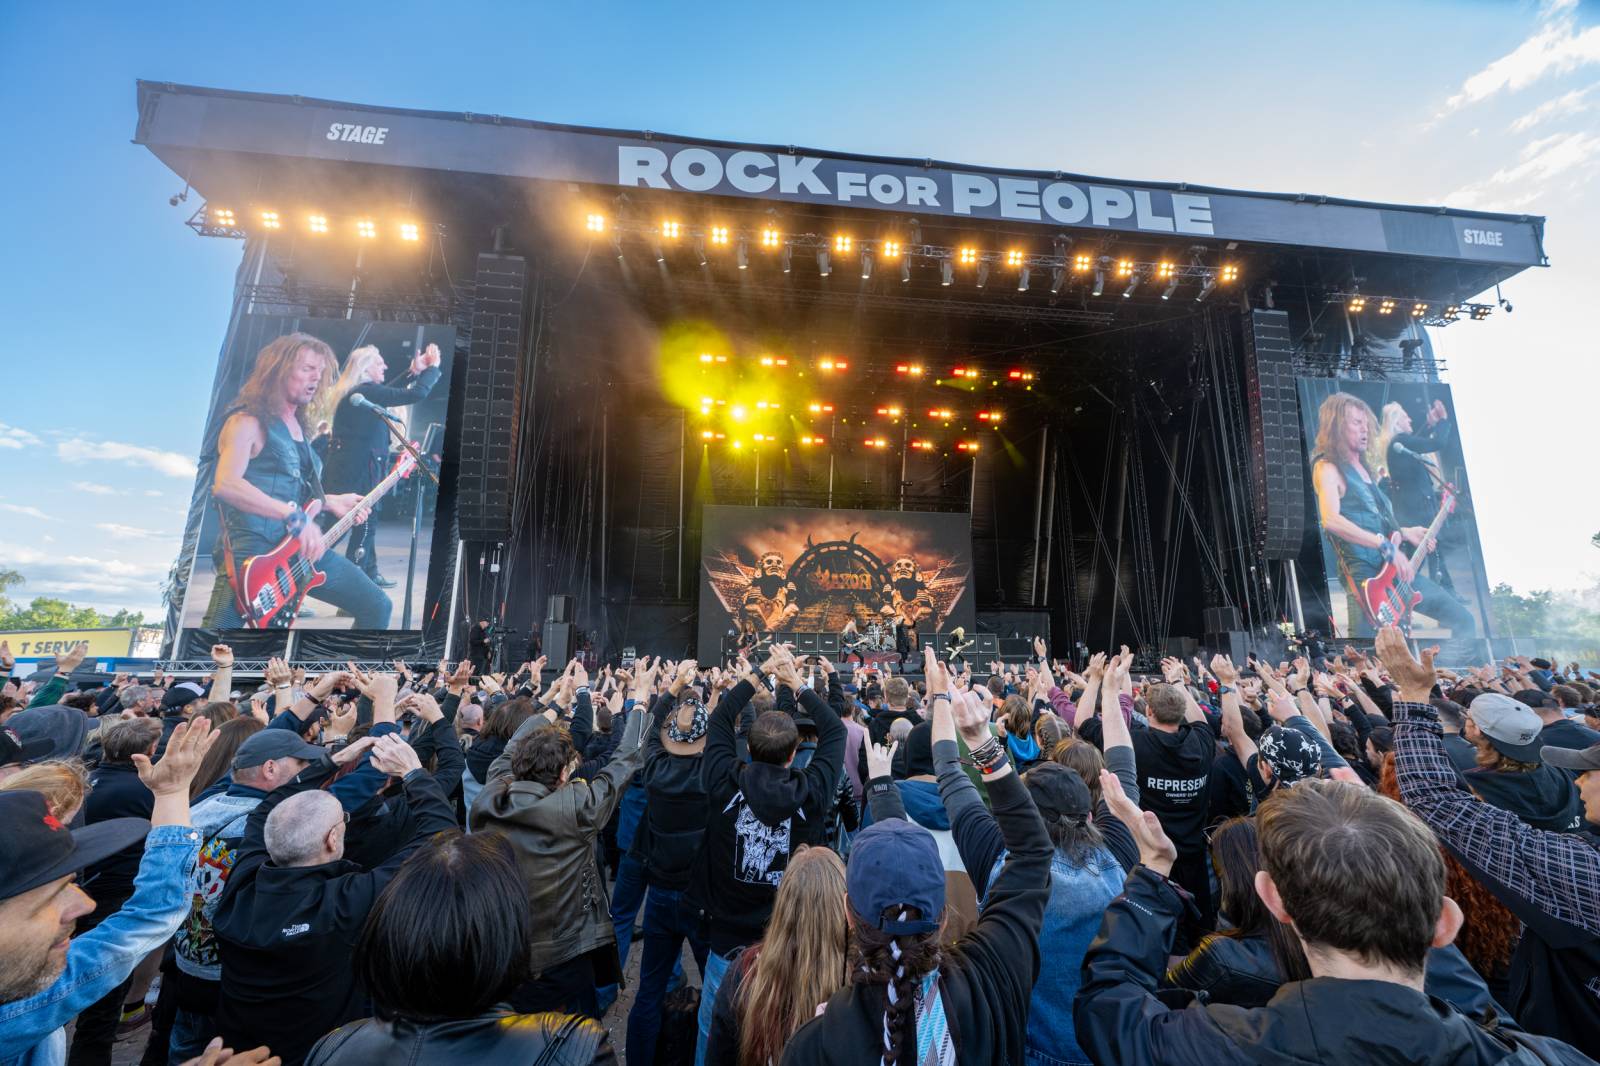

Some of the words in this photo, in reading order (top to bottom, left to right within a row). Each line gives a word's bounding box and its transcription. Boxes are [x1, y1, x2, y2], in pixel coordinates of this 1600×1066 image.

[326, 123, 389, 144] STAGE
[618, 145, 832, 195] ROCK
[837, 171, 941, 208] FOR
[951, 173, 1214, 235] PEOPLE
[1463, 229, 1504, 247] STAGE
